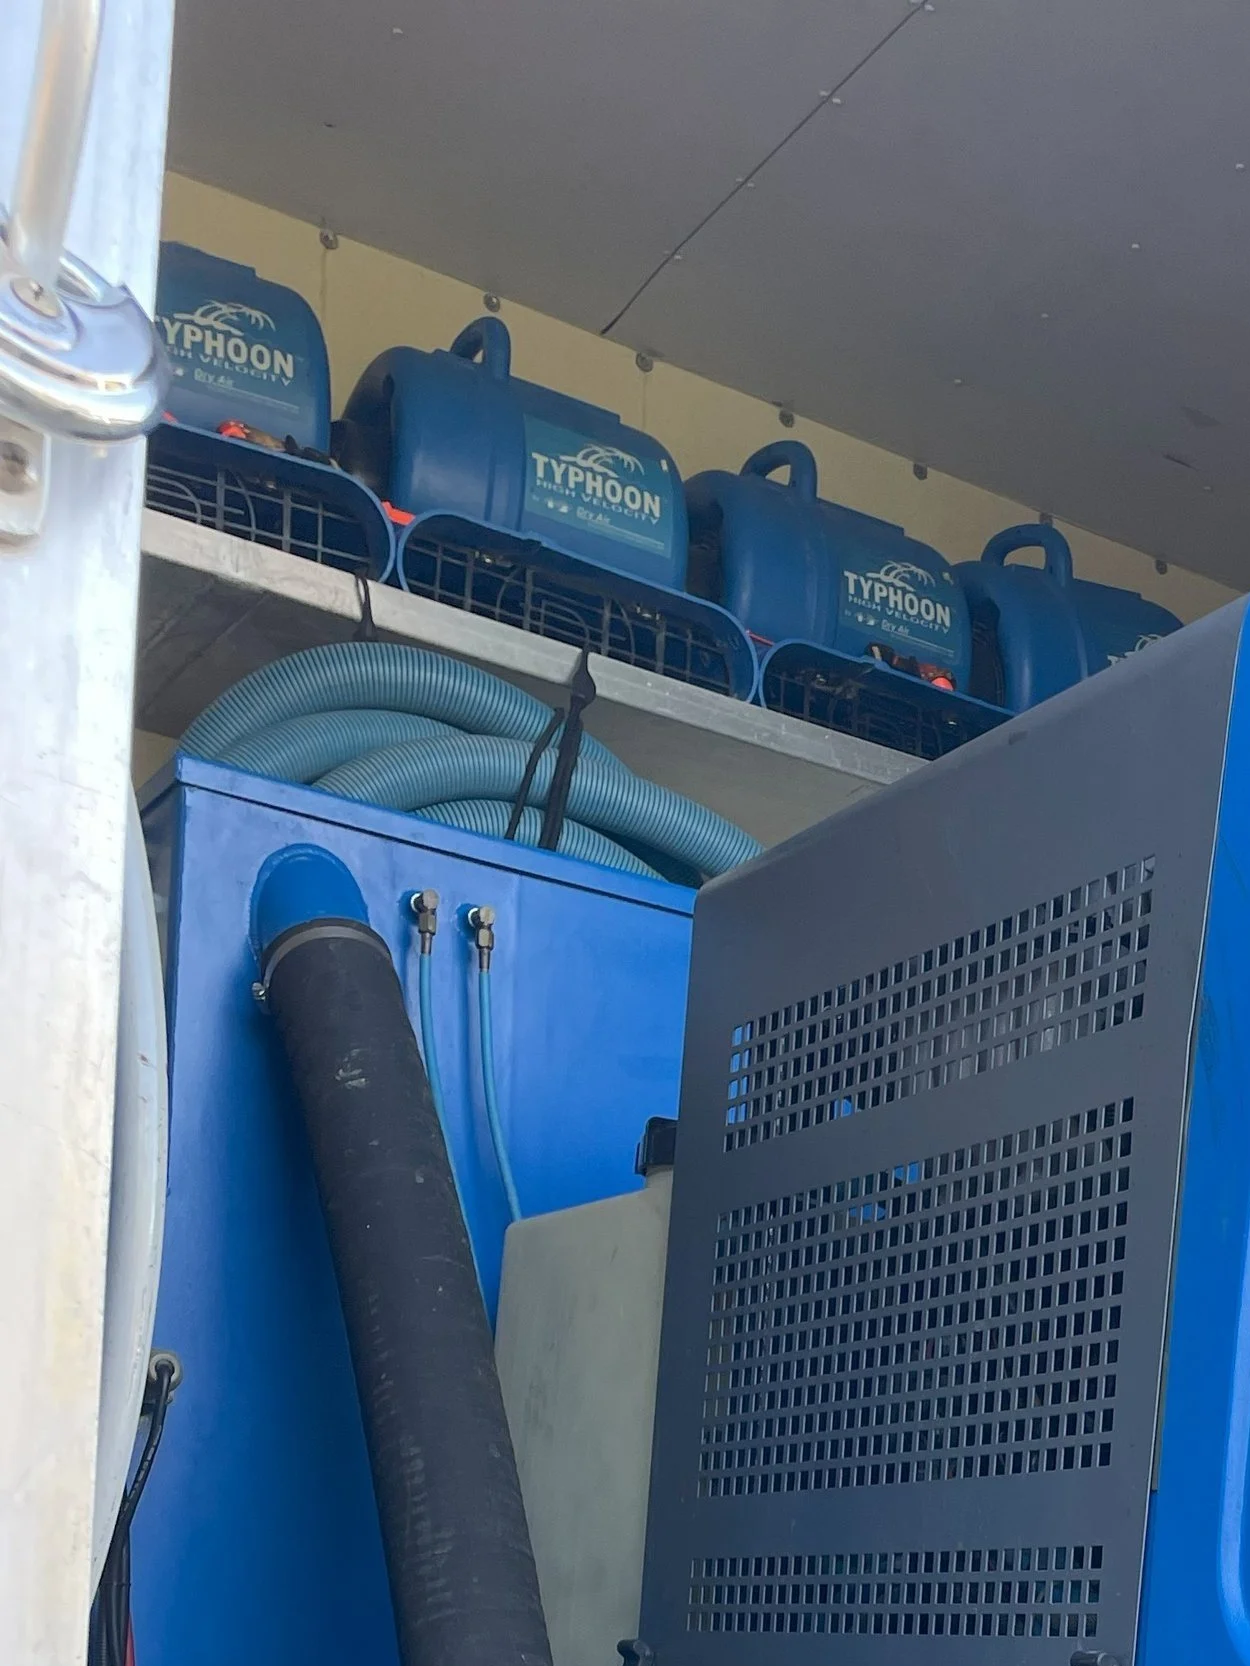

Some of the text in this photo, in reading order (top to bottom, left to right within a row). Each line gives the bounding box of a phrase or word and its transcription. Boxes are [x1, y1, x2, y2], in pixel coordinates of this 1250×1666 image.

[156, 315, 294, 379] YPHOON
[531, 452, 661, 518] TYPHOON
[581, 494, 660, 525] VELOCITY
[843, 571, 950, 627] TYPHOON
[885, 608, 949, 634] VELOCITY
